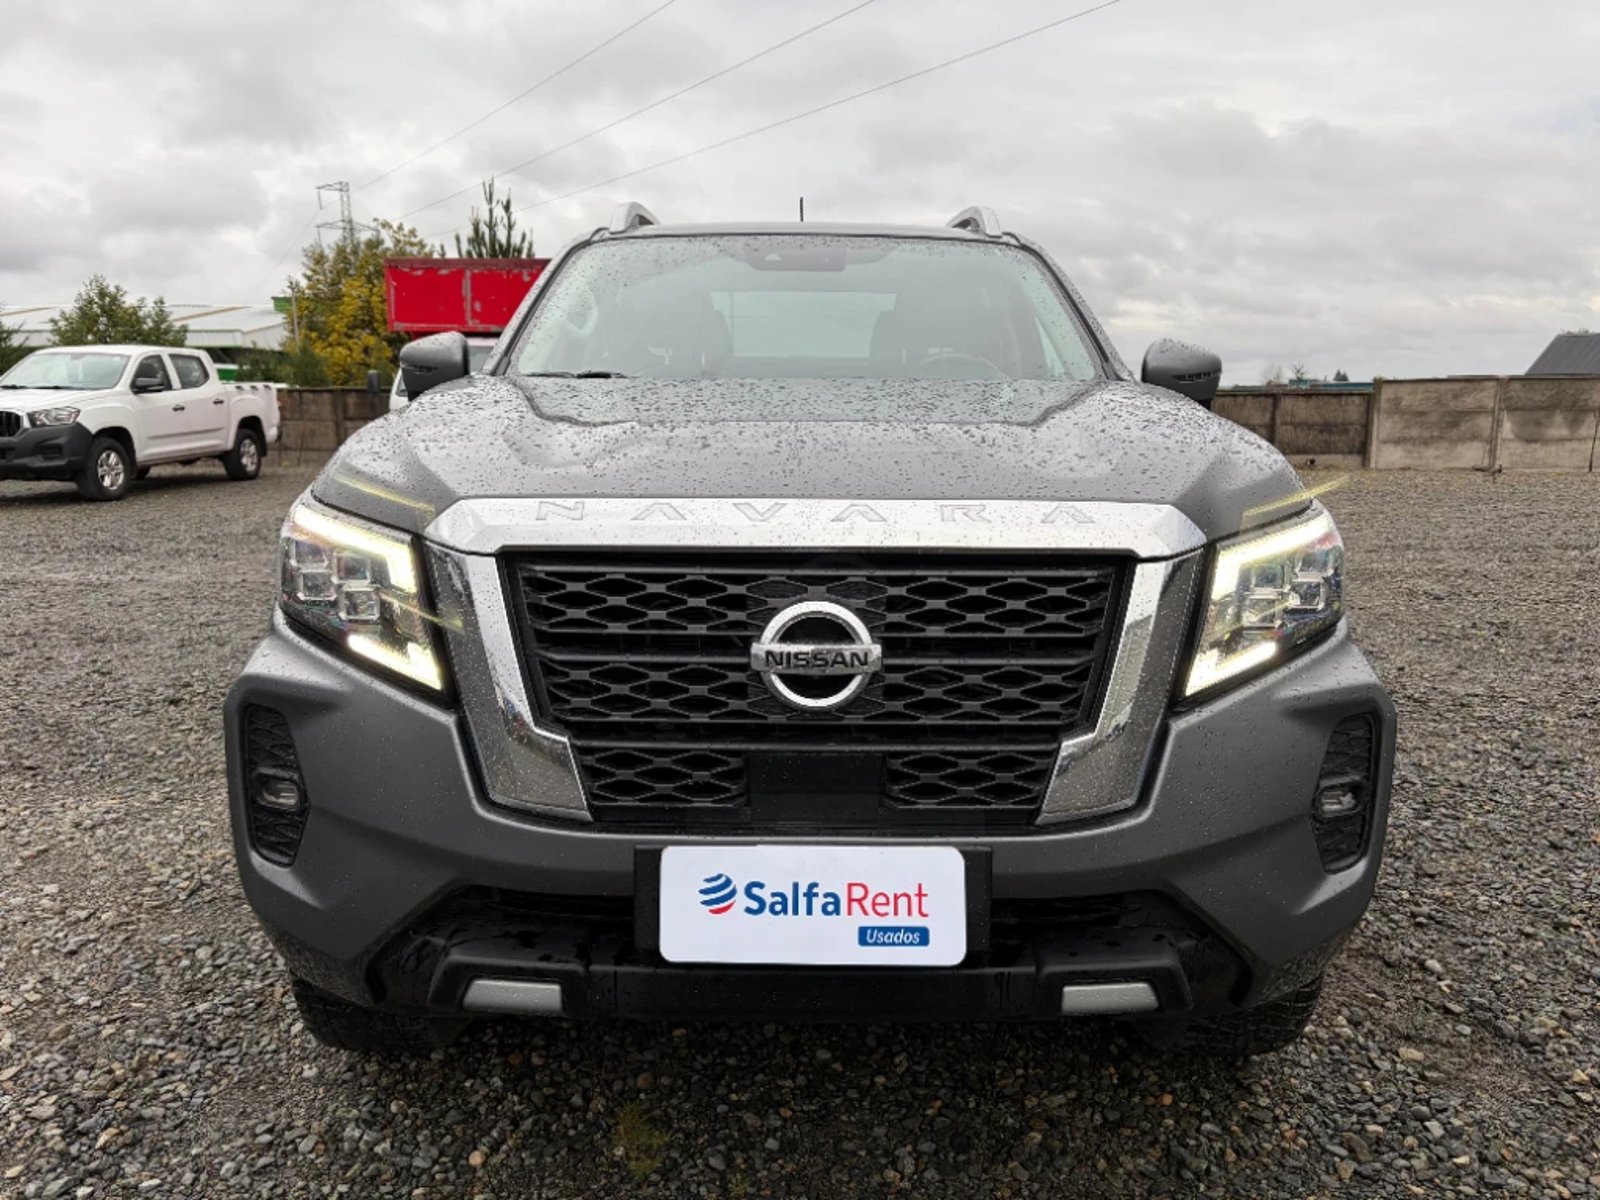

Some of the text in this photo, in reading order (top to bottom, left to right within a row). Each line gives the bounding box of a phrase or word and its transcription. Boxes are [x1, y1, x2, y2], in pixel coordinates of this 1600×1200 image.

[536, 501, 1094, 524] NAVARA
[764, 650, 868, 669] NISSAN
[743, 881, 929, 917] SalfaRent
[866, 928, 920, 944] Usados
